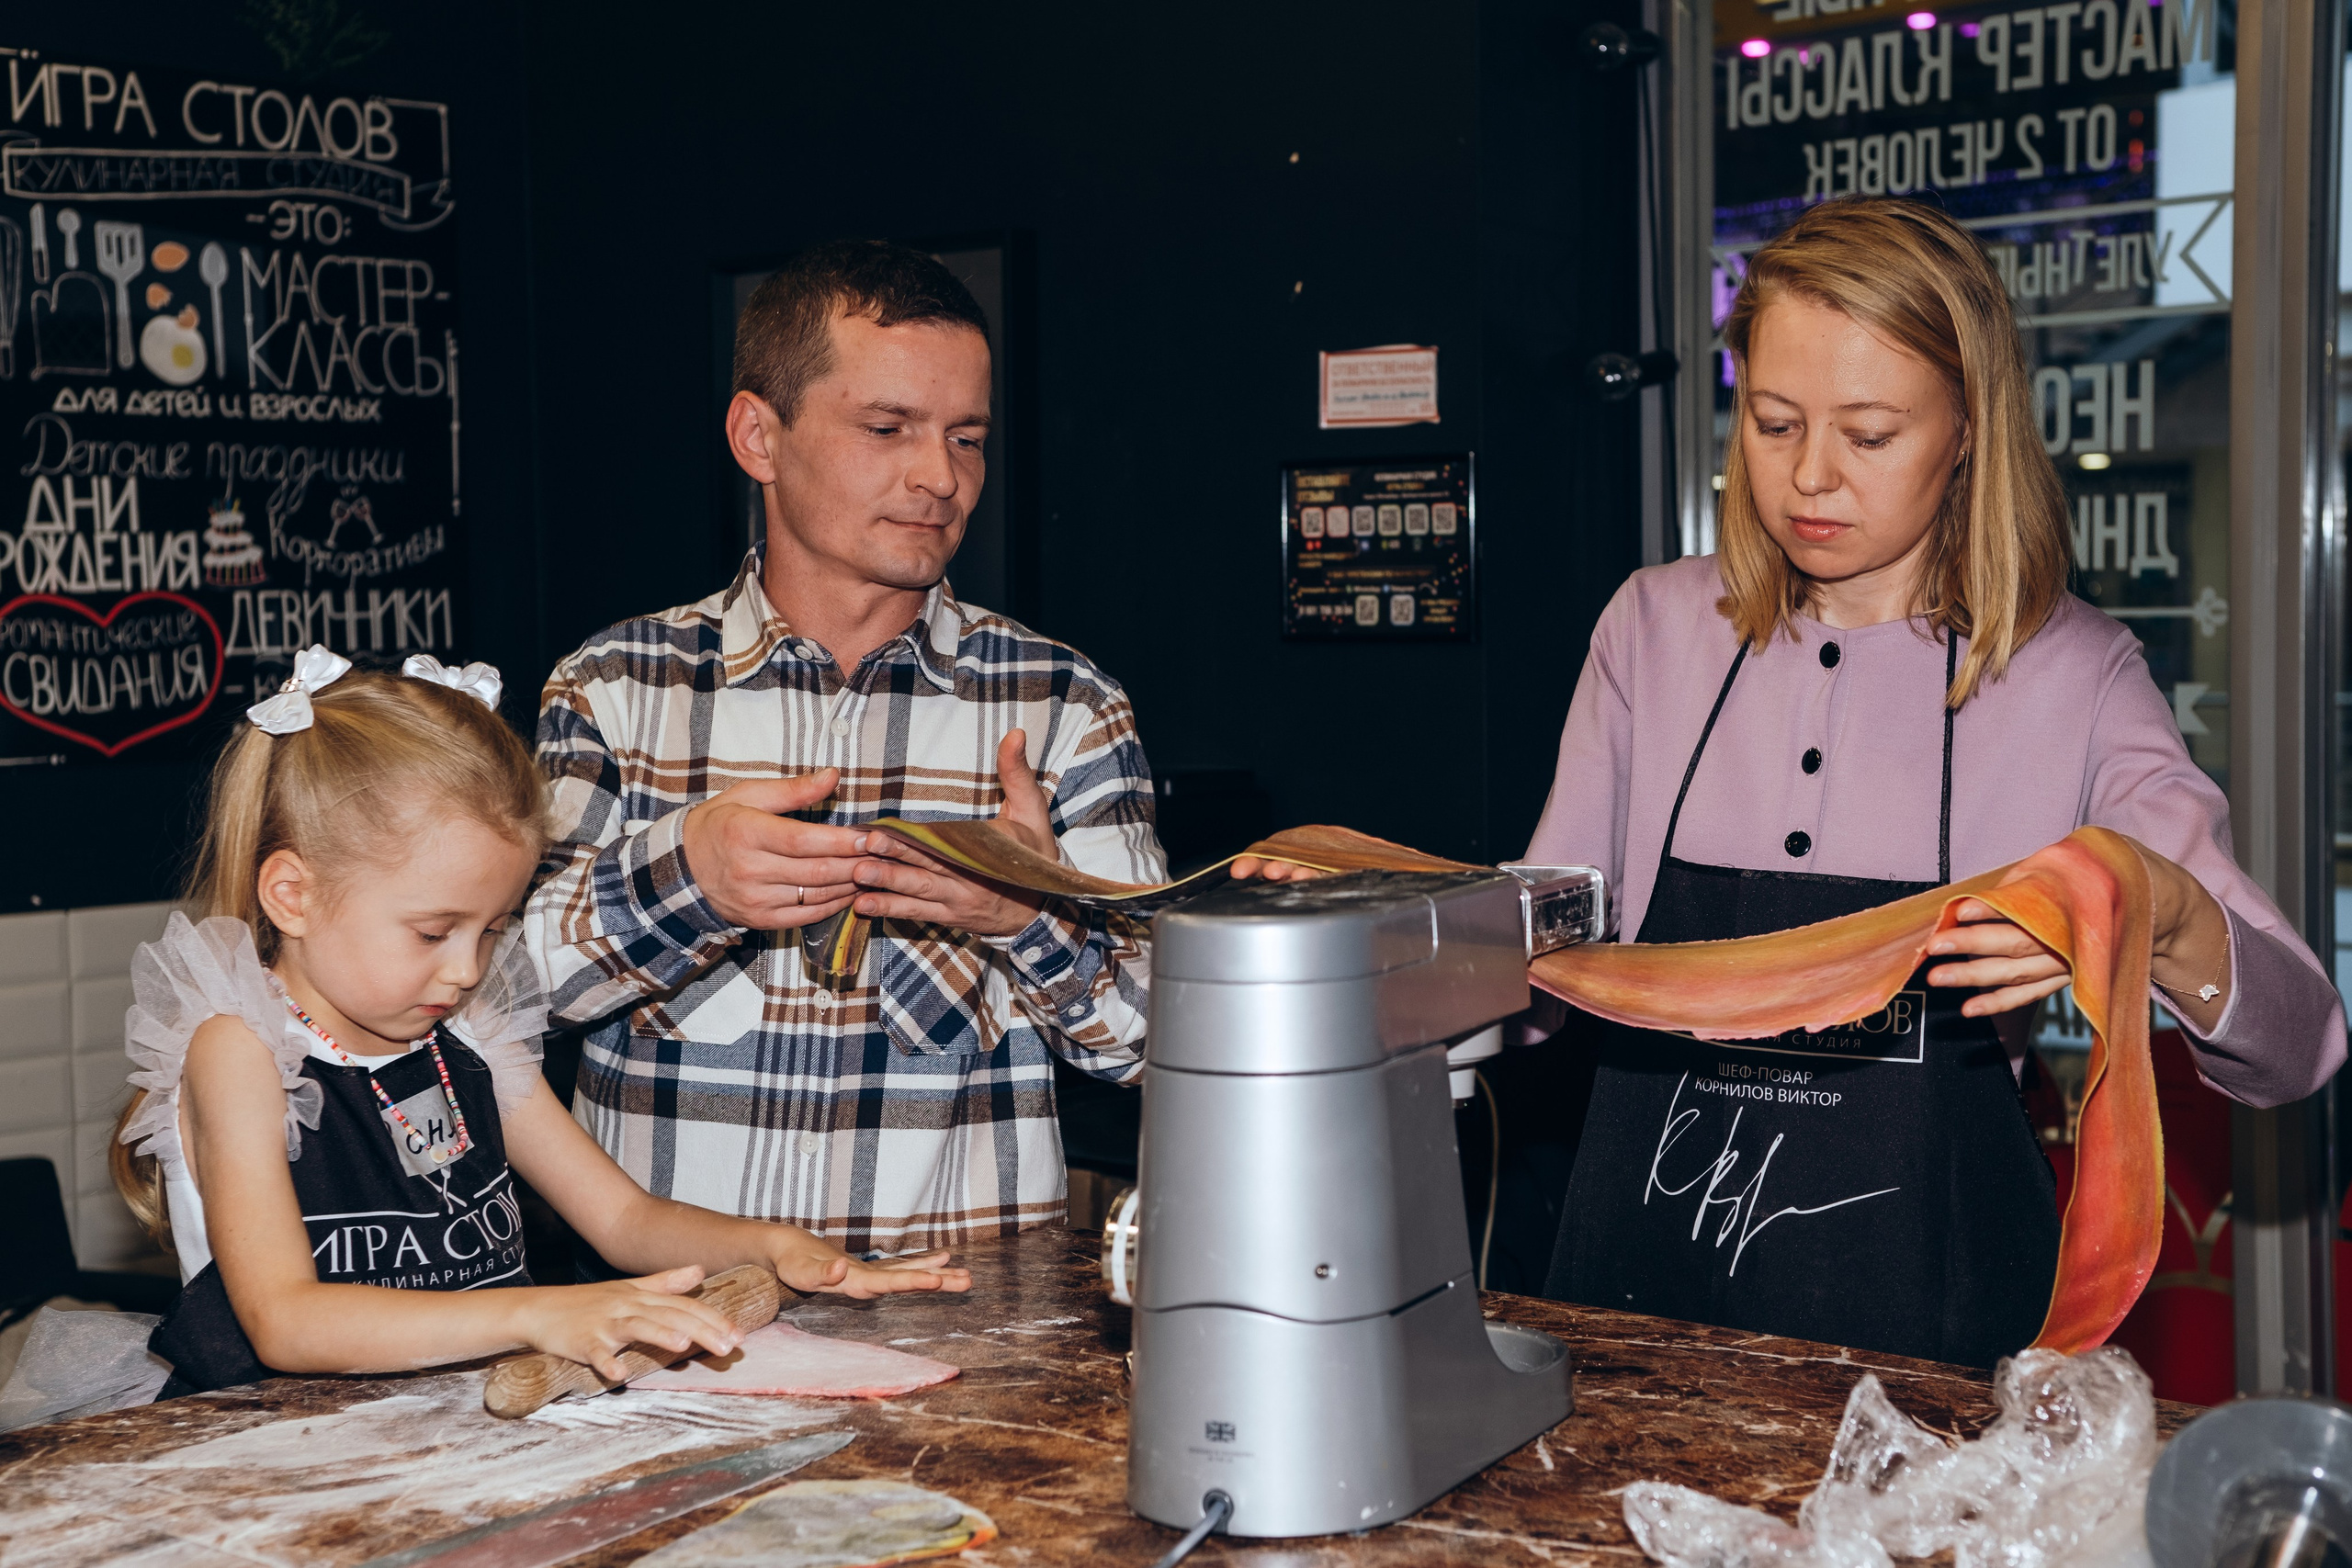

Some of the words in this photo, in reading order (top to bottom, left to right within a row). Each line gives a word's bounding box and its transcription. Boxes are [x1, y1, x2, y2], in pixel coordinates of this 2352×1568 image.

[8, 59, 156, 138] ИГРА
[183, 81, 398, 159] СТОЛОВ
[13, 156, 240, 193] КУЛИНАРНАЯ
[266, 155, 399, 210] СТУДИЯ
[241, 247, 450, 327] МАСТЕР-
[246, 321, 458, 398] КЛАССЫ
[20, 412, 191, 478] Детские
[206, 442, 406, 514] праздники
[22, 474, 141, 535] ДНИ
[0, 529, 202, 595] РОЖДЕНИЯ
[268, 510, 446, 590] Корпоративы
[224, 589, 453, 658] ДЕВИЧНИКИ
[3, 643, 209, 716] СВИДАНИЯ
[1717, 1062, 1814, 1086] ШЕФ-ПОВАР
[1792, 1033, 1861, 1050] СТУДИЯ
[1694, 1077, 1774, 1102] КОРНИЛОВ
[1777, 1089, 1843, 1107] ВИКТОР
